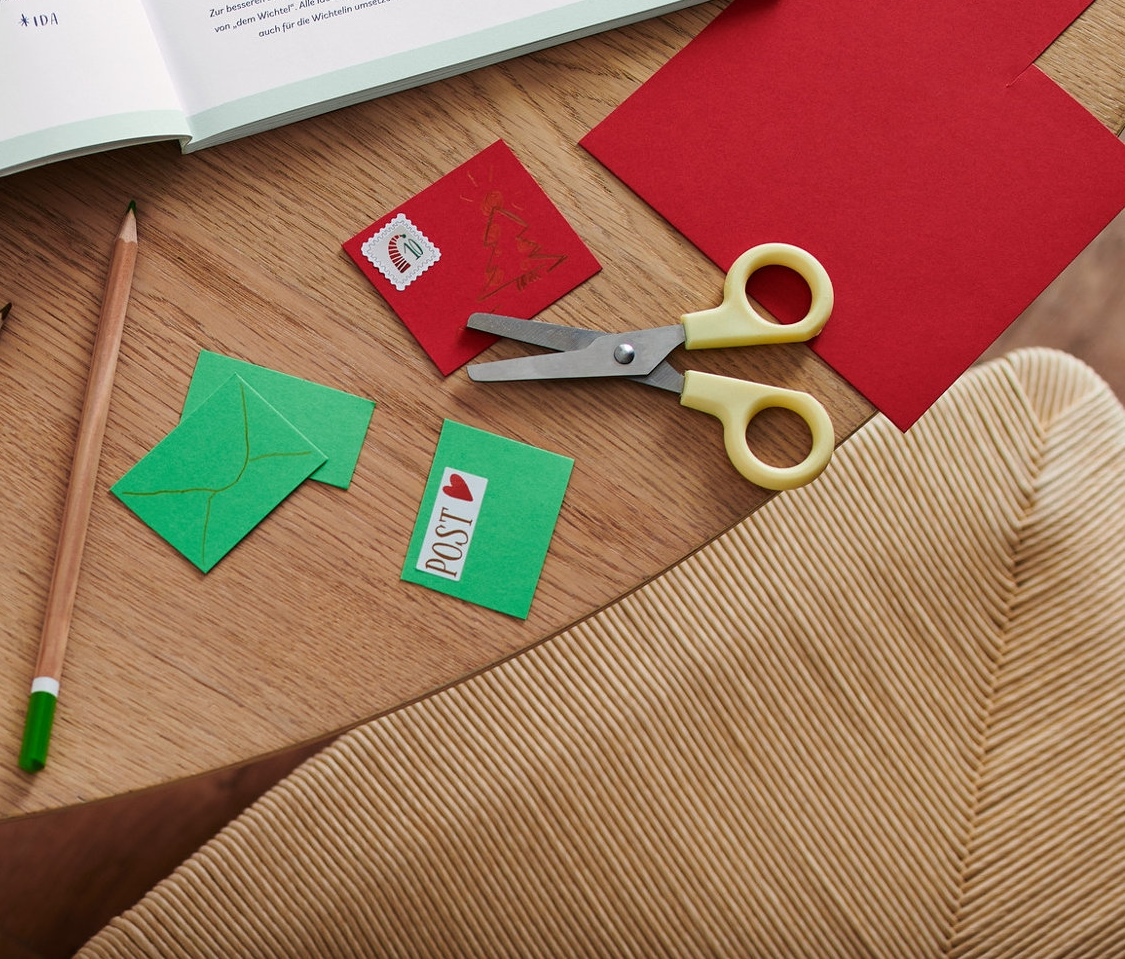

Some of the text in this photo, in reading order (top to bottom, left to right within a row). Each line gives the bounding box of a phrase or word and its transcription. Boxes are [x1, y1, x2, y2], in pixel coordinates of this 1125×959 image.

[33, 12, 59, 27] IDA
[209, 8, 225, 18] Zur
[214, 23, 231, 33] von
[299, 0, 315, 10] Alle
[258, 25, 281, 38] auch
[282, 22, 295, 33] für
[296, 17, 310, 27] die
[311, 6, 353, 22] Wichtelin
[404, 238, 423, 260] 10
[425, 507, 473, 578] POST
